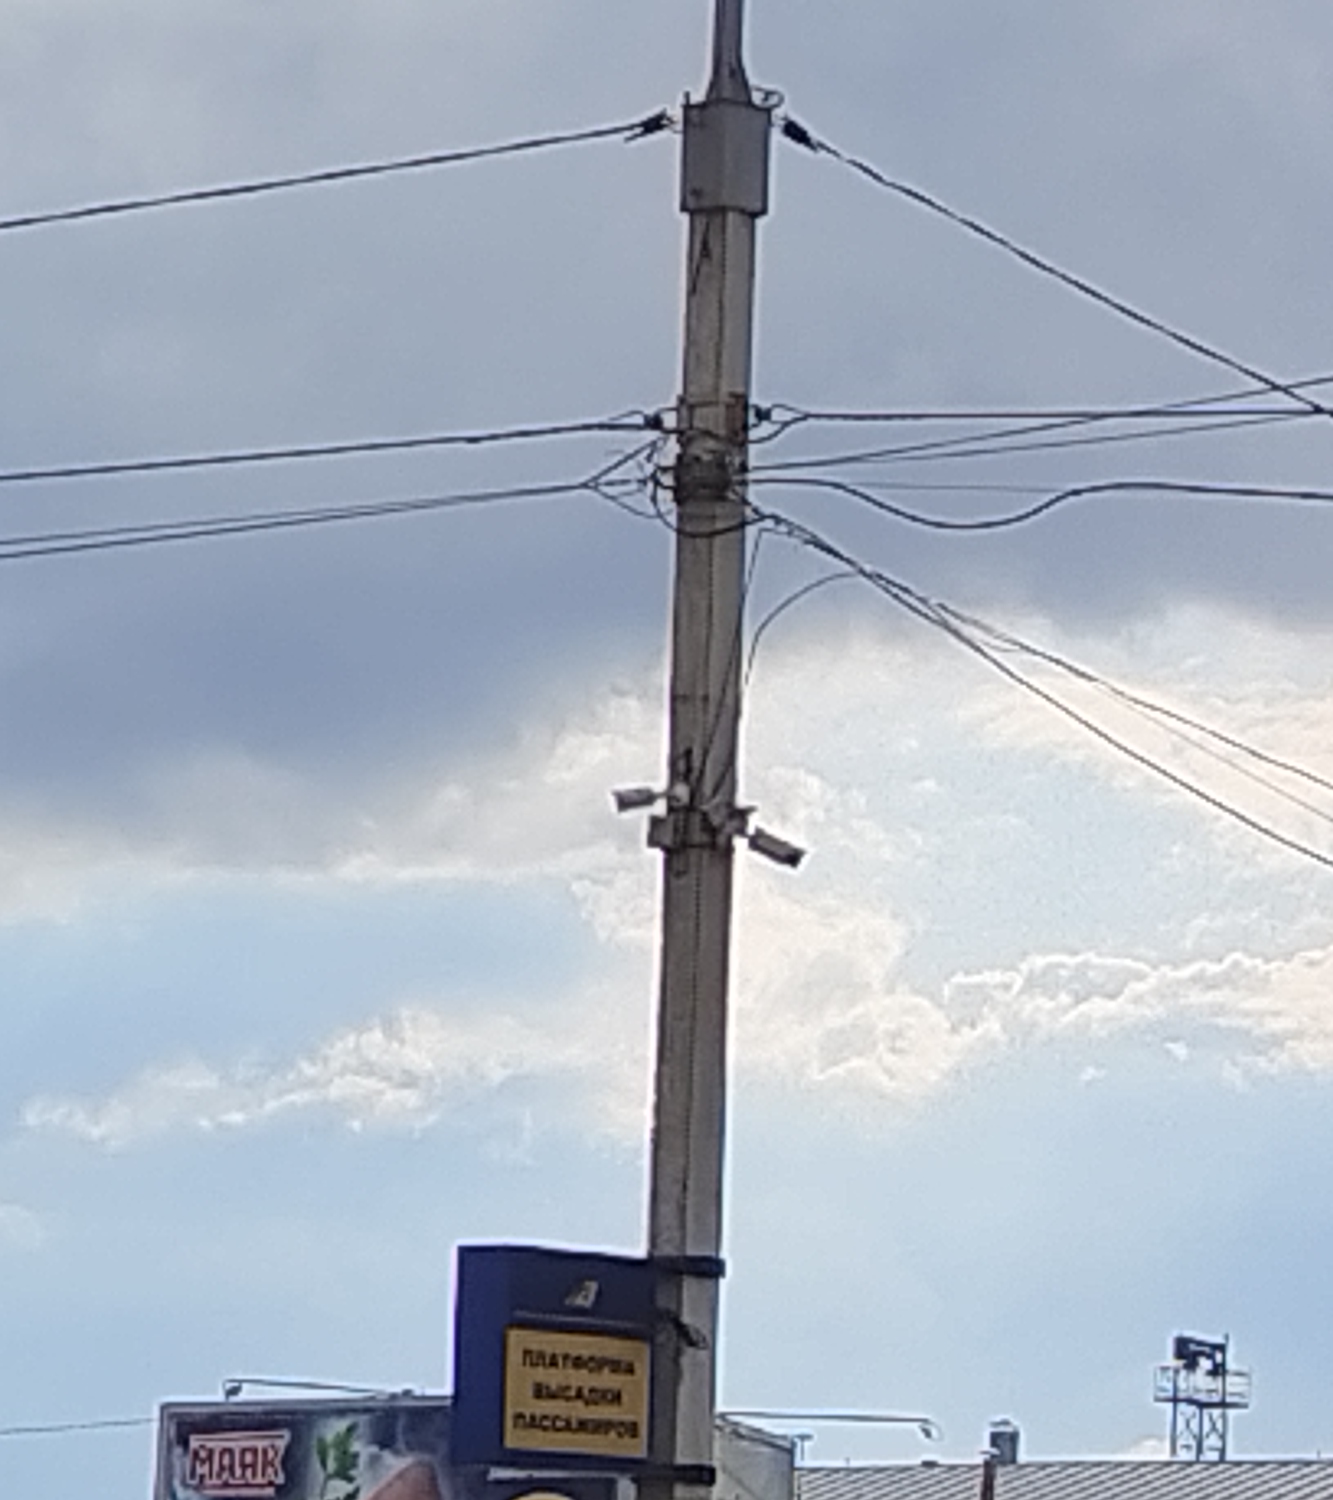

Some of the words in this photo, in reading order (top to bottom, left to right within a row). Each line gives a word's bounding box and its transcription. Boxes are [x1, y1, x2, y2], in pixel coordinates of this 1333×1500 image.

[522, 1348, 635, 1377] ПЛАТФОРМА
[532, 1382, 623, 1407] ВЫСАДКИ
[512, 1411, 640, 1439] ПАССАЖИРОВ
[187, 1442, 286, 1484] МАЯК
